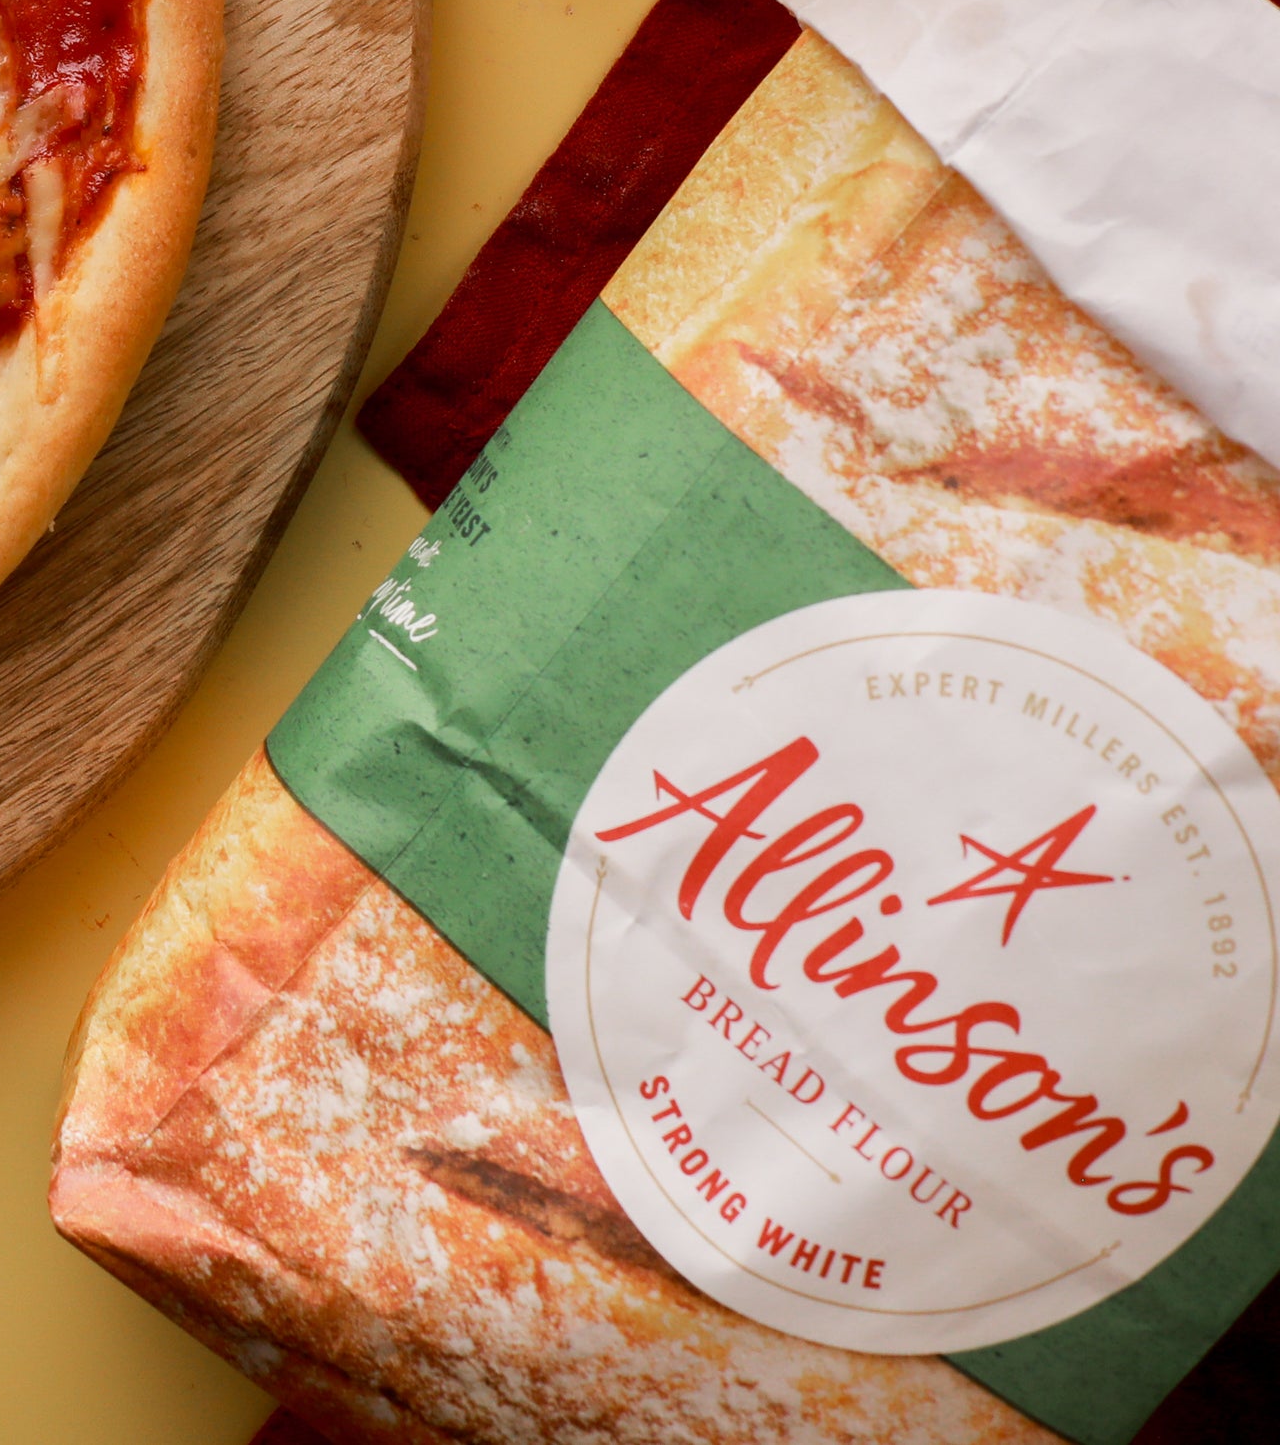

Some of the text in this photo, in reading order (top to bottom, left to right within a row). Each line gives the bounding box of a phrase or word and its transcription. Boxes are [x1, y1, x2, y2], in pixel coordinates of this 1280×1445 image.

[448, 493, 491, 547] YEAST
[866, 672, 1237, 978] EXPERT MILLERS EST. 1892
[594, 735, 1216, 1217] Allinson's
[680, 974, 974, 1230] BREAD FLOUR
[639, 1075, 885, 1290] STRONG WHITE
